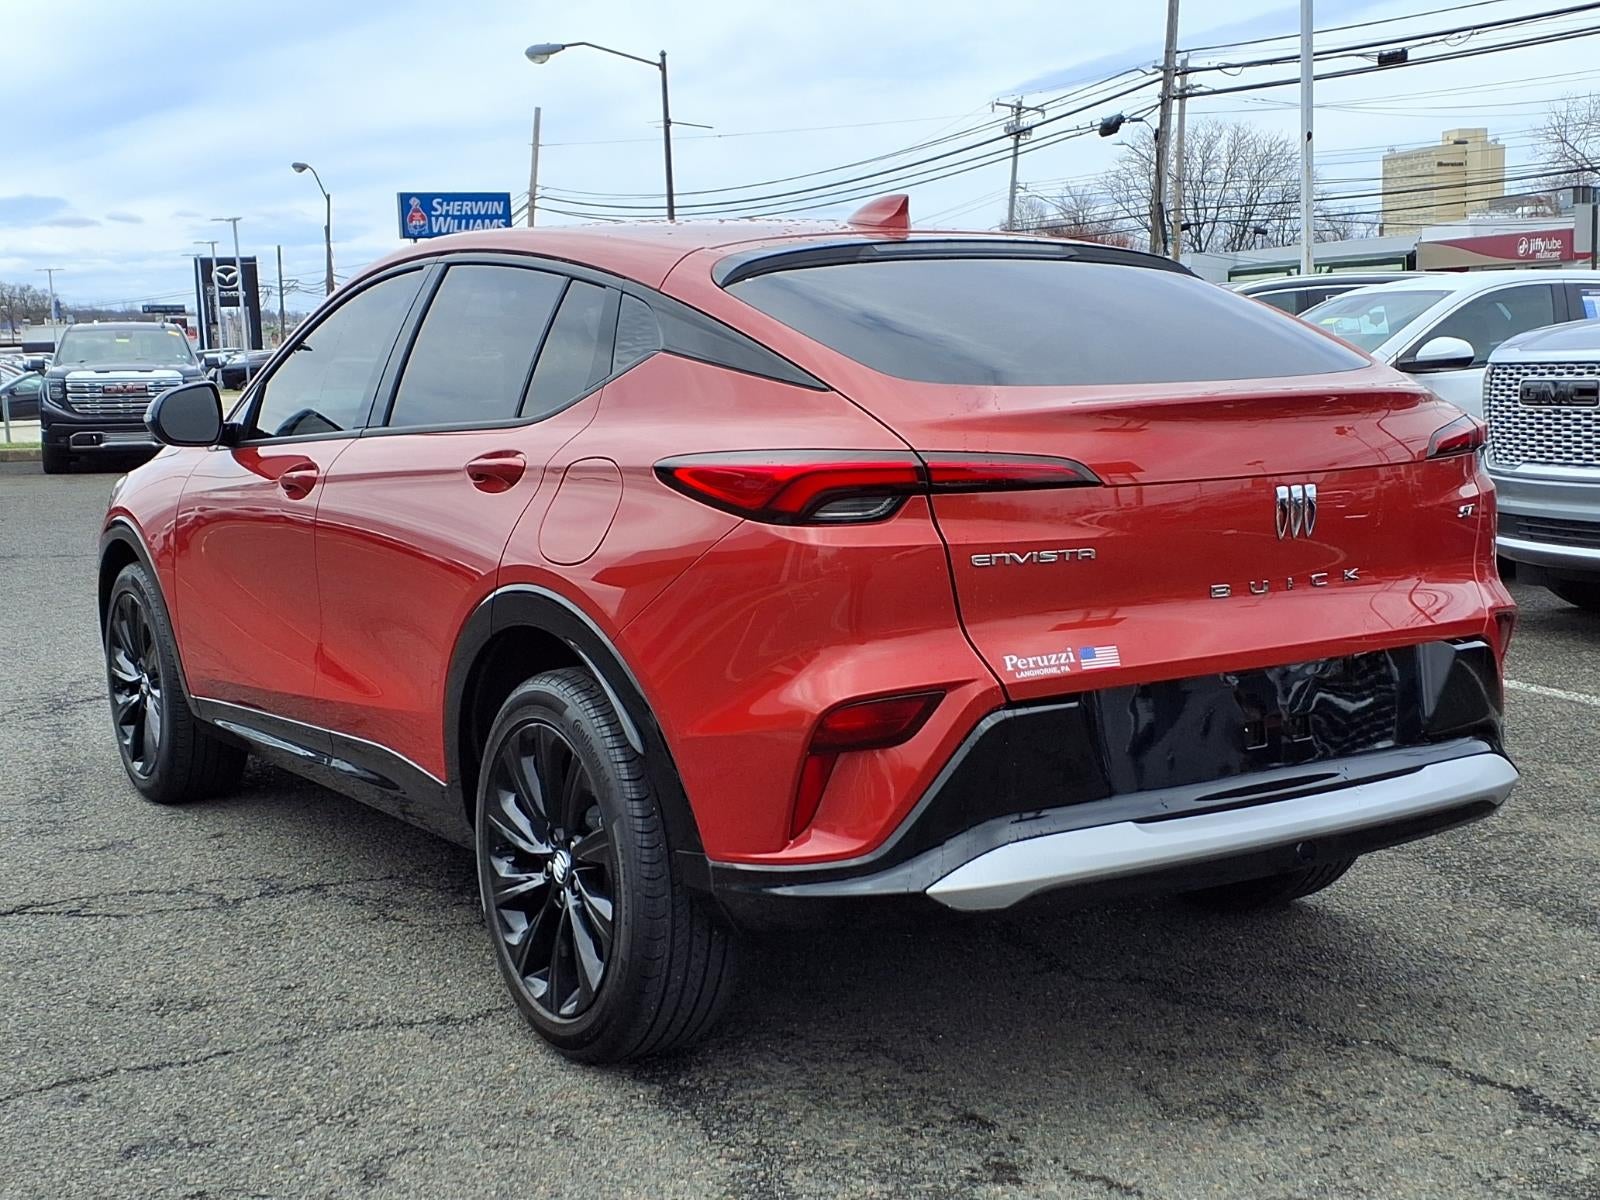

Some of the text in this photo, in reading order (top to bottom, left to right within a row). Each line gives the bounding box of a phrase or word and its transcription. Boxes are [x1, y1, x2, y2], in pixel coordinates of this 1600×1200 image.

[431, 198, 504, 215] SHERWIN
[431, 216, 506, 233] WILLIAMS
[1521, 380, 1599, 404] GMC
[971, 548, 1096, 566] ENVISTA
[1210, 567, 1360, 599] BUICK
[1003, 647, 1076, 671] Peruzzi
